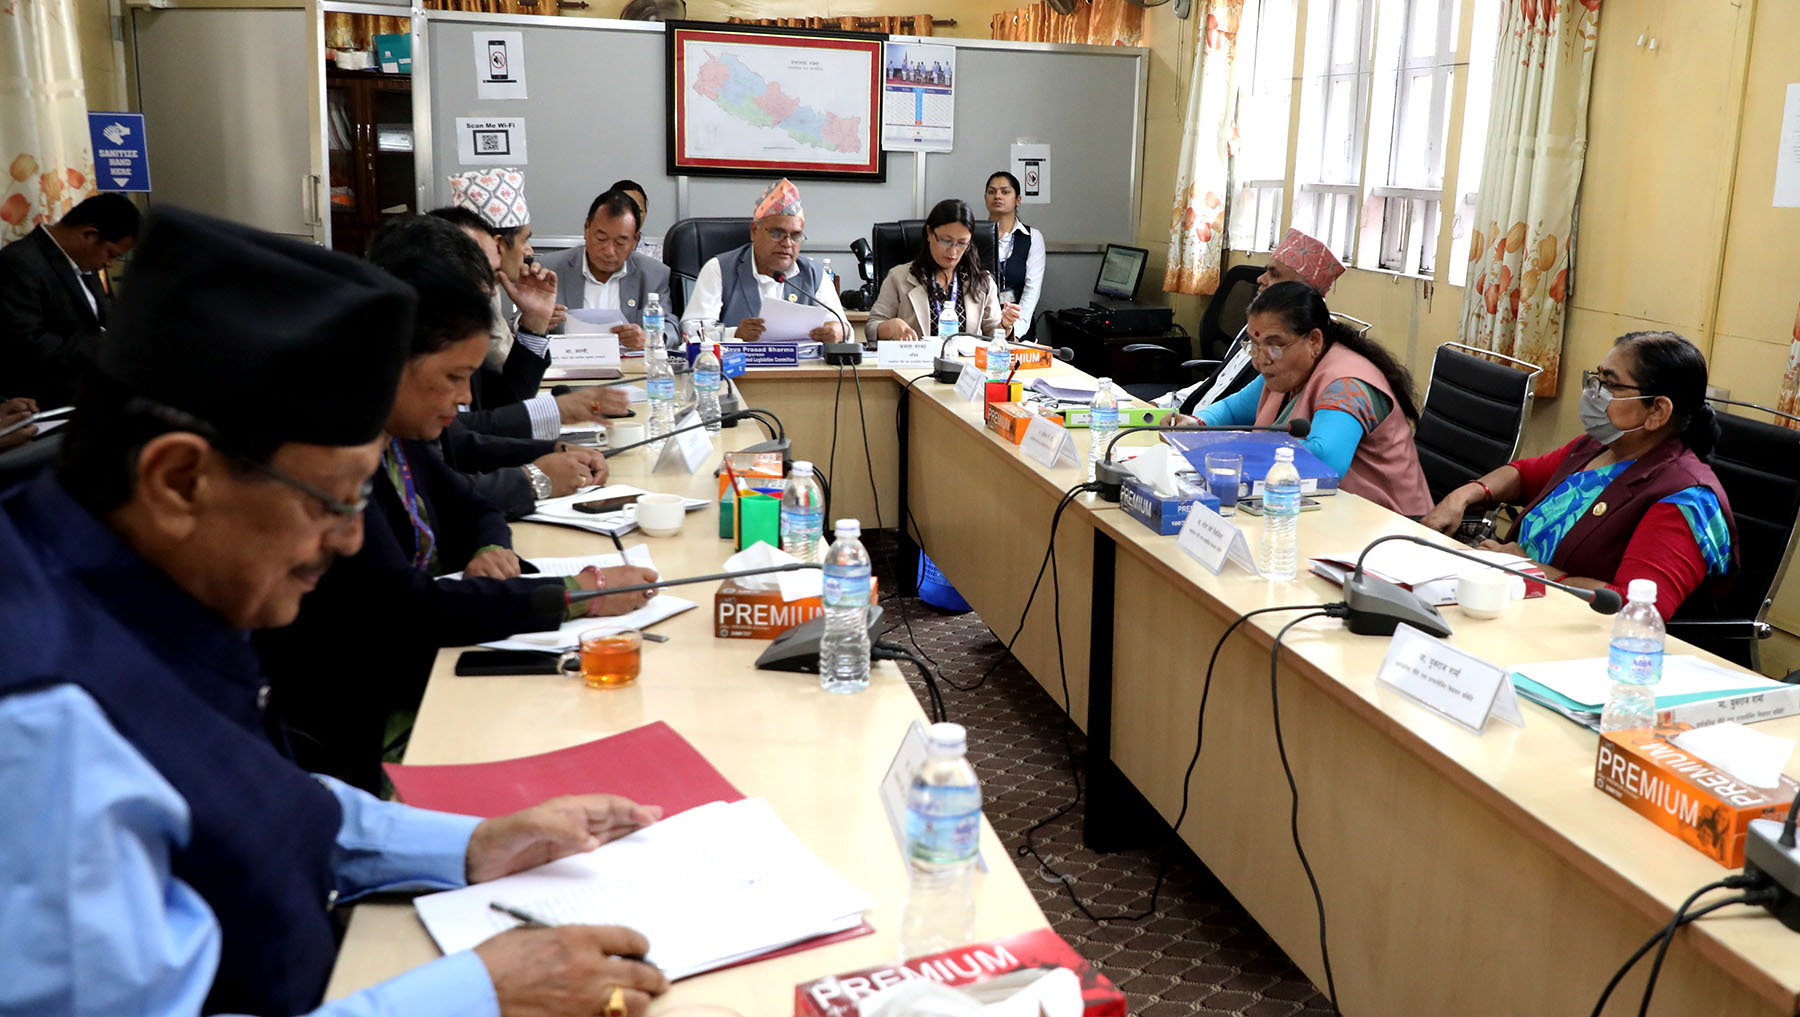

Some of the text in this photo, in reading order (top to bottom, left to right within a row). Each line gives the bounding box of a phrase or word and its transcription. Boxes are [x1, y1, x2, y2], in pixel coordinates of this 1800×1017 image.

[98, 149, 138, 158] SANITIZE
[110, 168, 132, 176] HERE
[1009, 352, 1040, 364] EMIUM
[1120, 484, 1152, 518] PREMIUM
[1598, 745, 1699, 828] PREMIUM
[1639, 742, 1764, 806] PREMIUM
[810, 944, 1019, 1011] PREMIUM
